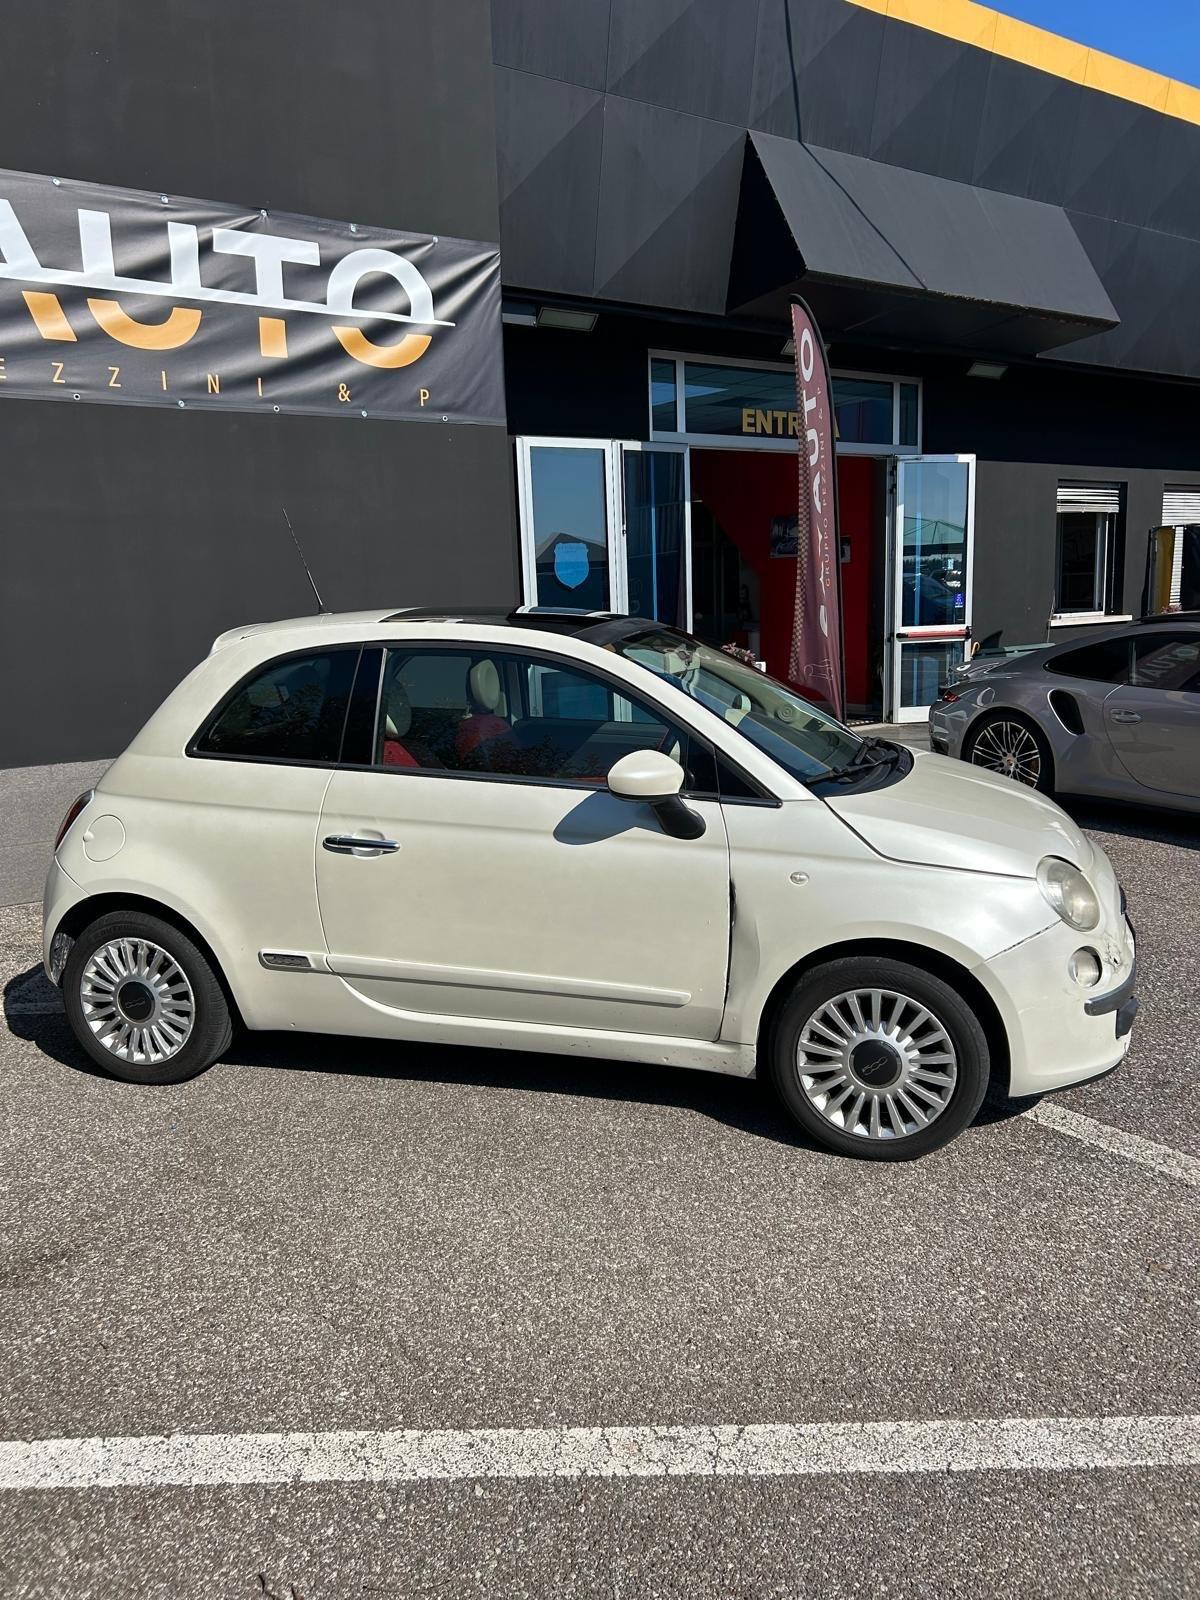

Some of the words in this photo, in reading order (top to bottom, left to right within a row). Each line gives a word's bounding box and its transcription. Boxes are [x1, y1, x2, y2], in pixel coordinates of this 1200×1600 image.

[338, 383, 351, 403] &
[419, 388, 430, 407] P
[742, 407, 840, 439] ENTR
[823, 517, 831, 588] GRUPPO
